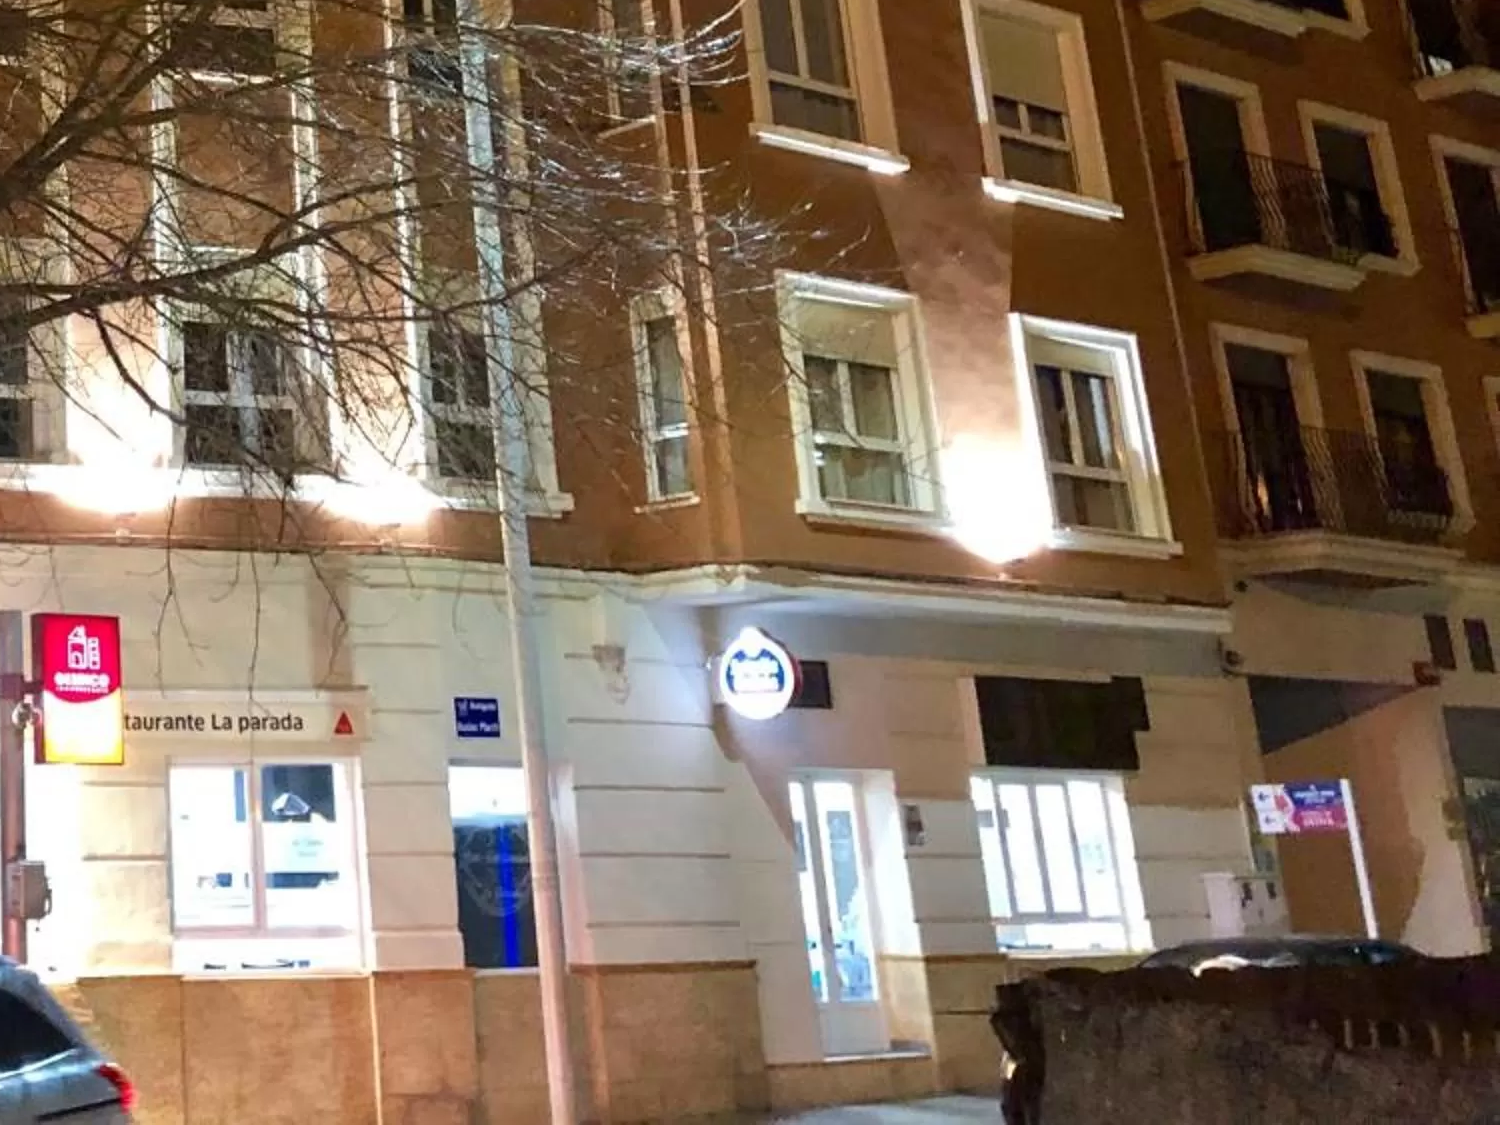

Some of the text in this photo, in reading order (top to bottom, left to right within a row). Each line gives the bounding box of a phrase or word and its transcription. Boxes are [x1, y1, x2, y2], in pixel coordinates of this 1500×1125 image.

[124, 713, 304, 735] taurante La parada
